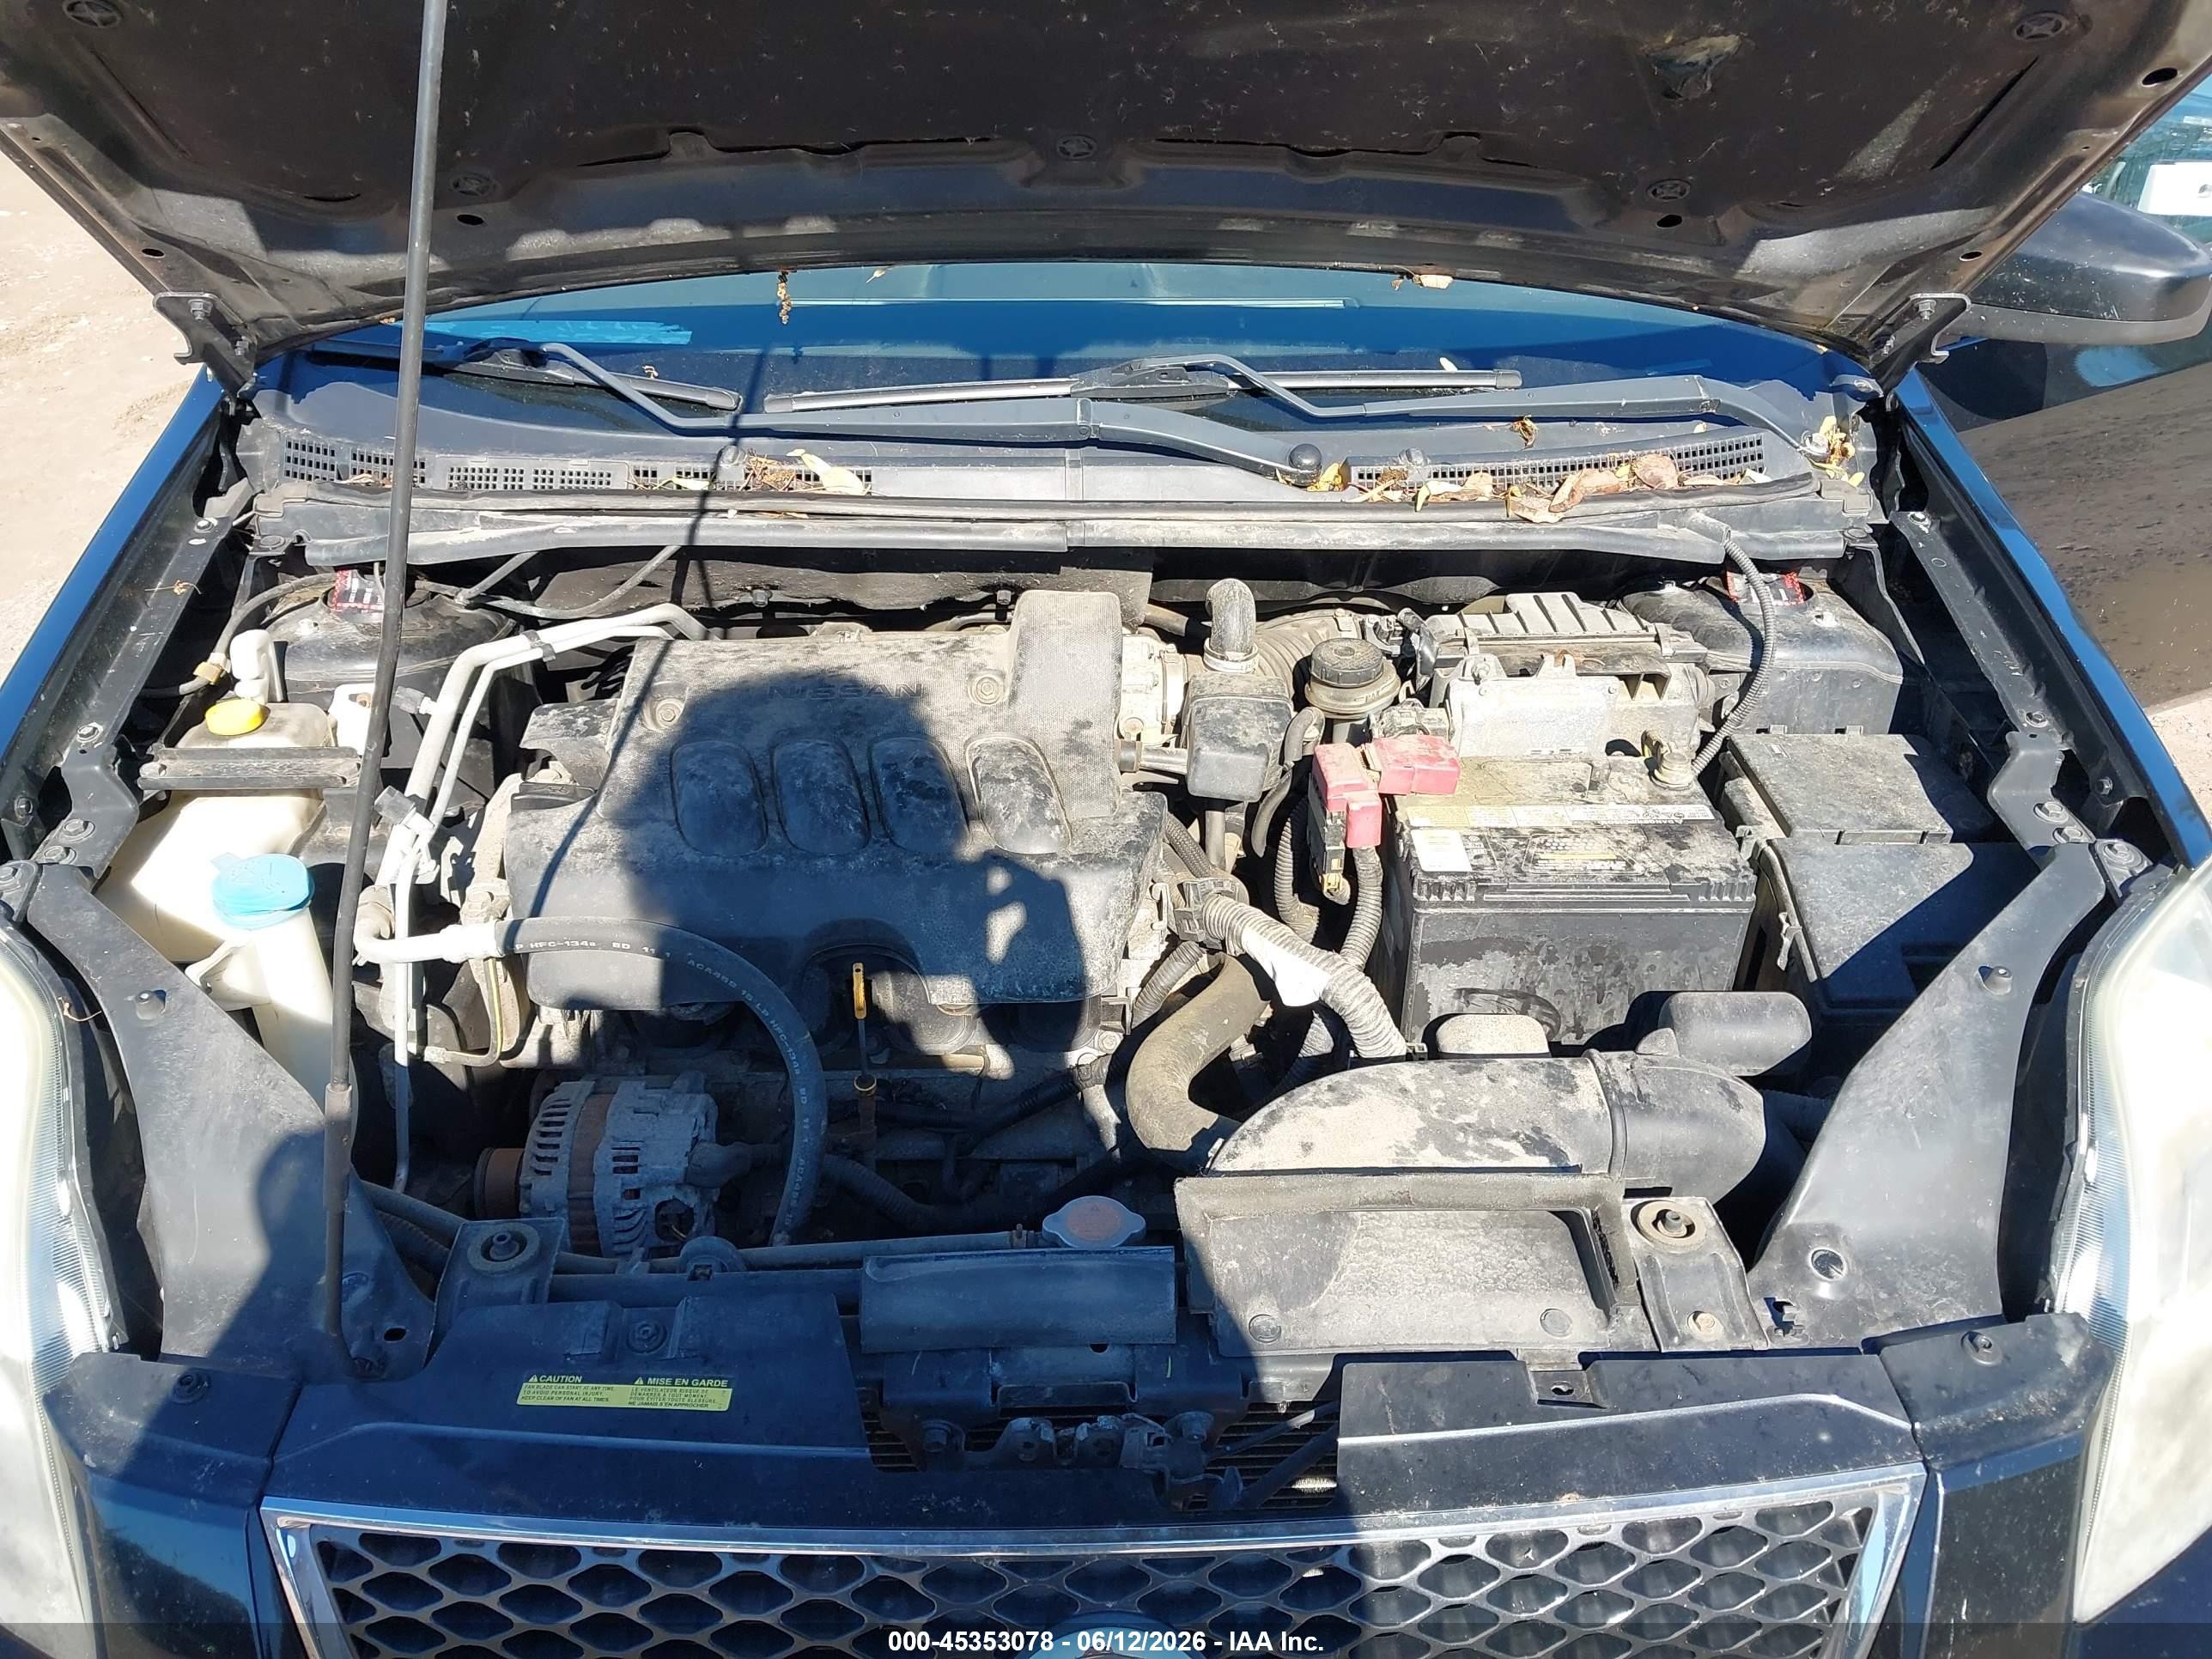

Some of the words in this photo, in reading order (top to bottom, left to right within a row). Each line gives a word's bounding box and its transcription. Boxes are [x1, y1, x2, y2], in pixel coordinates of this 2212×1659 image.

[768, 683, 922, 701] NISSAN
[530, 940, 596, 949] HFC-134a
[539, 1375, 583, 1383] CAUTION
[647, 1376, 672, 1386] MISE
[691, 1379, 729, 1388] GARDE
